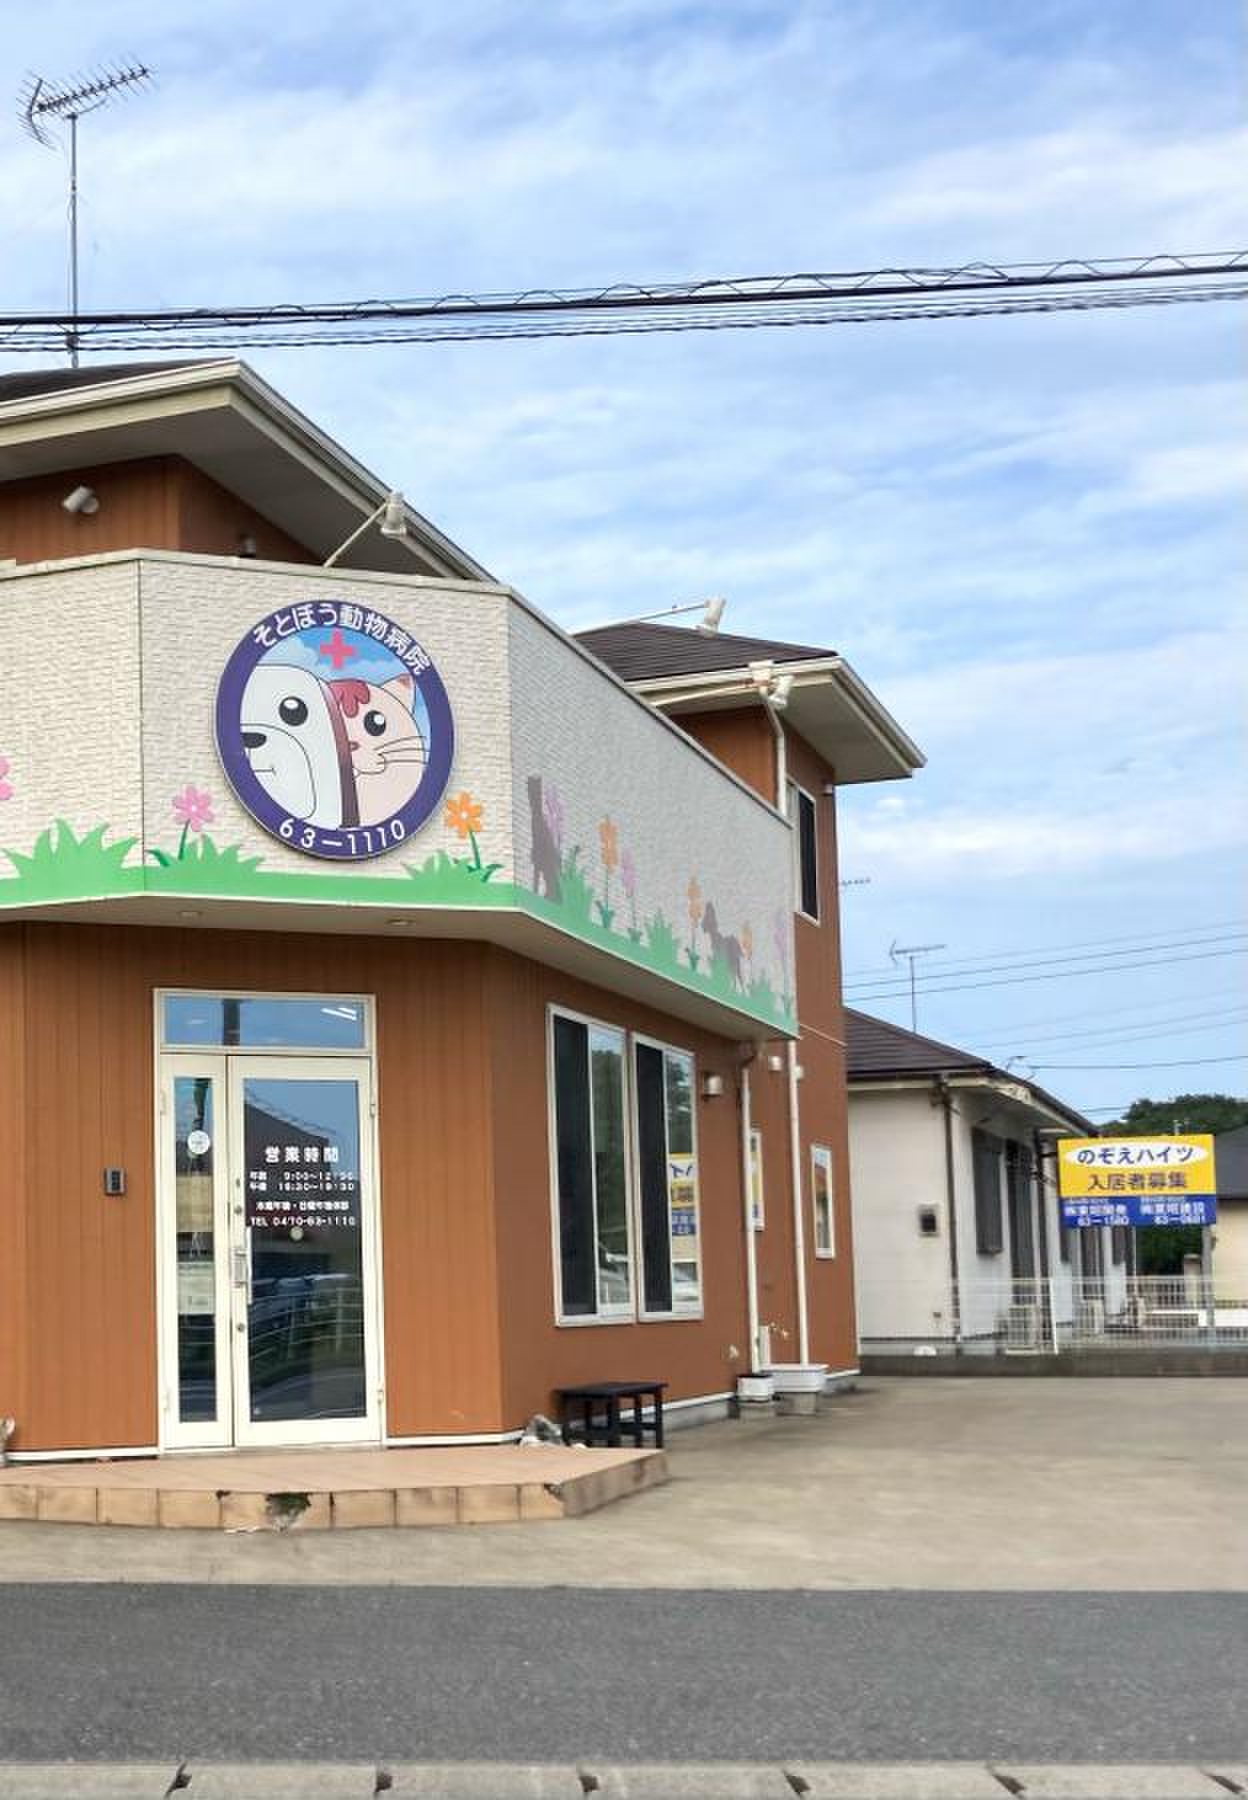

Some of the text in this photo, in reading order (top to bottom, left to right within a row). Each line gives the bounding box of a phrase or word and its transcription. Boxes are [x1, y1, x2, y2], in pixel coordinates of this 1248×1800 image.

[253, 602, 431, 676] そとぼう動物病院
[1077, 1146, 1194, 1165] のぞえハイツ
[1087, 1171, 1187, 1192] 入居者募集
